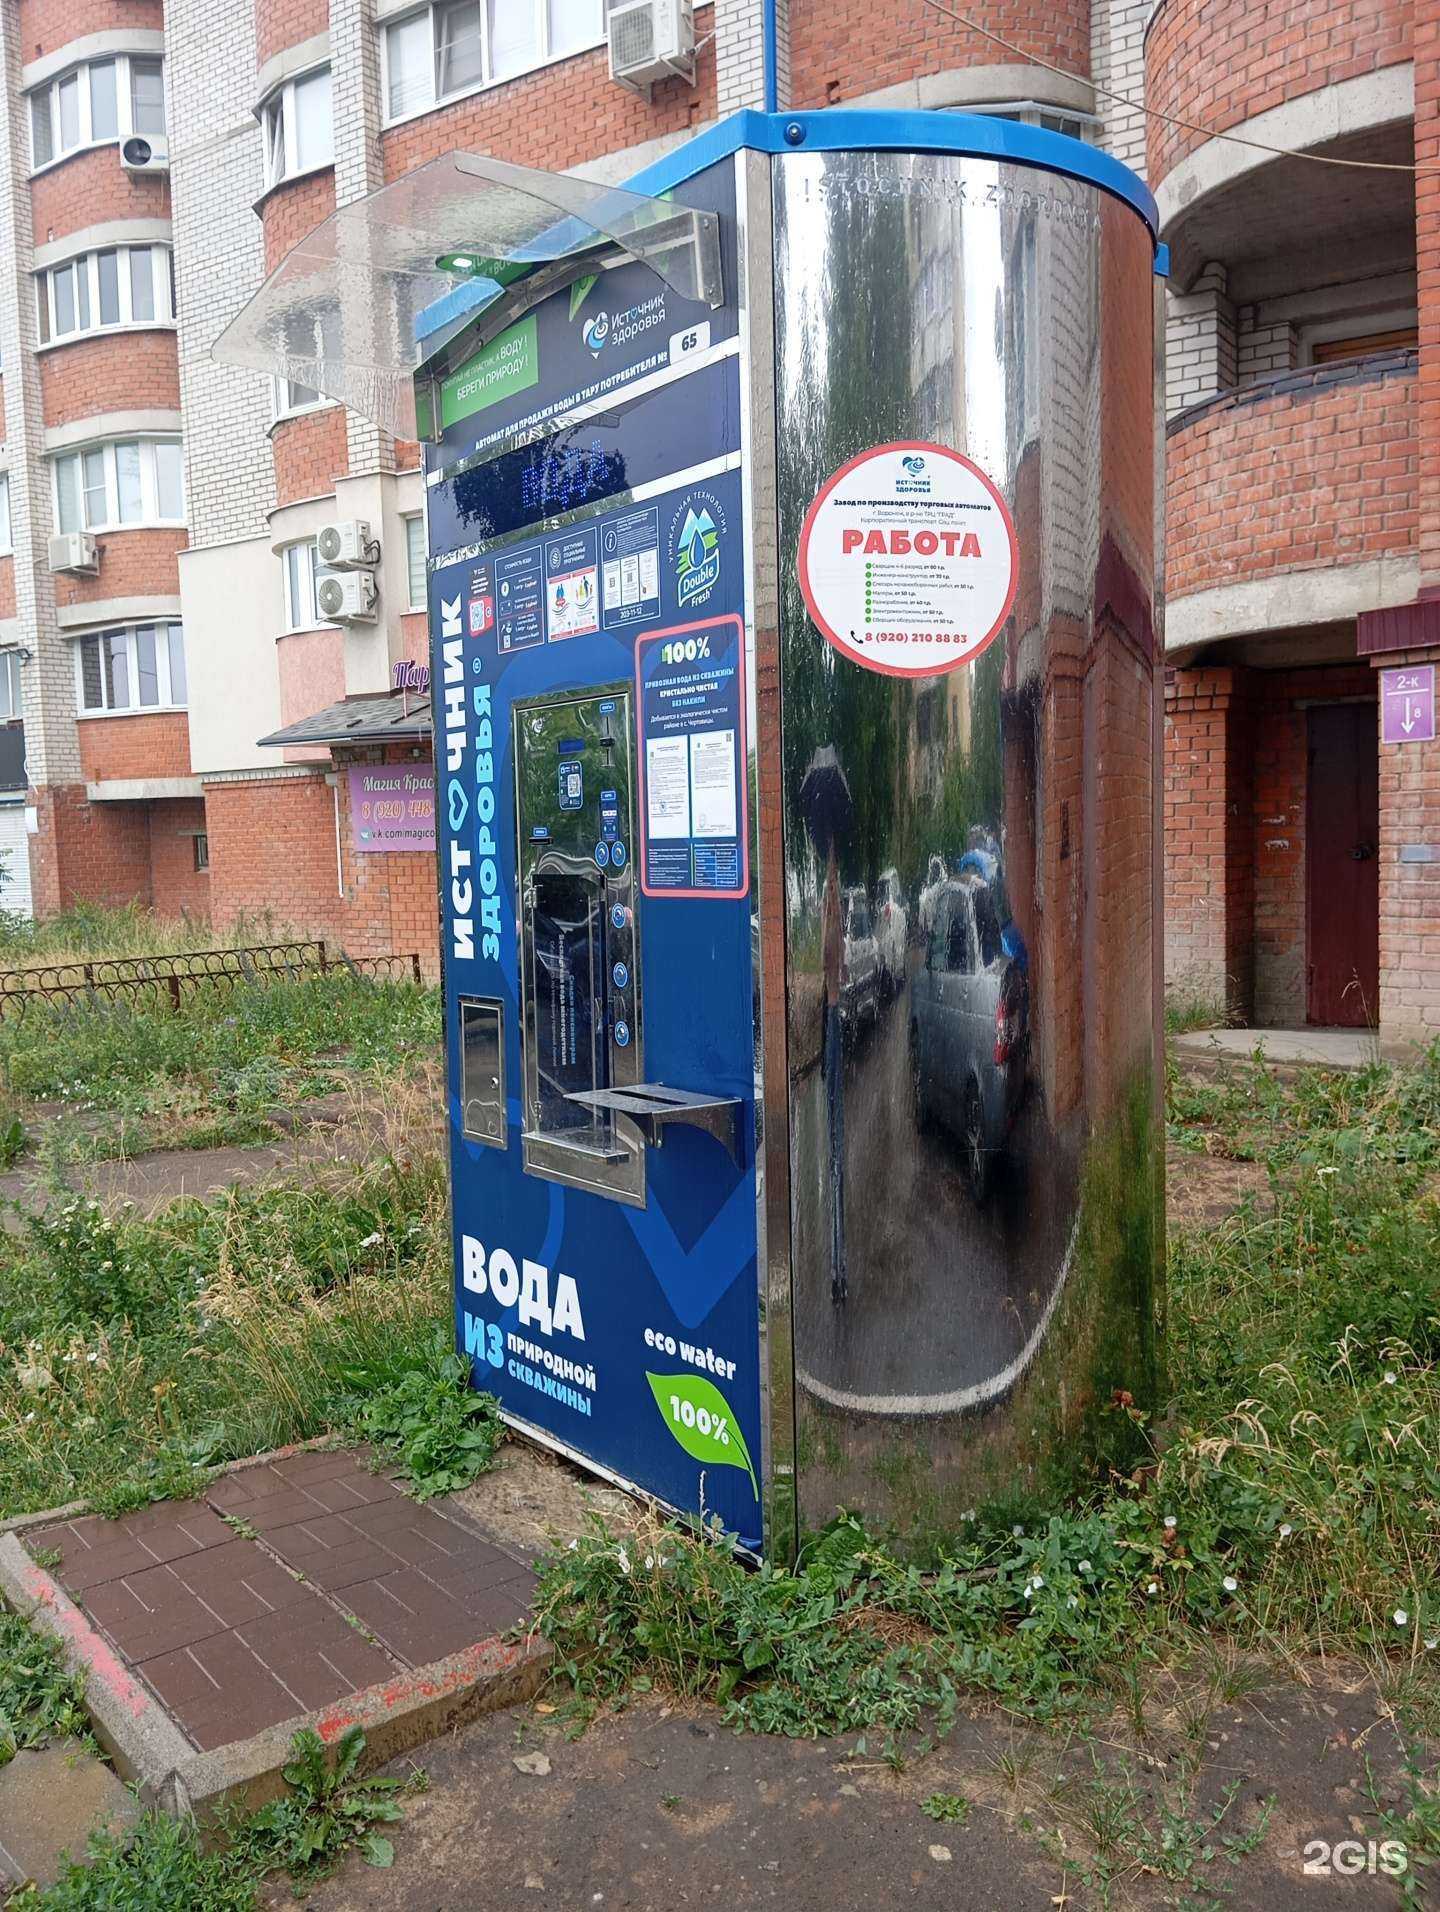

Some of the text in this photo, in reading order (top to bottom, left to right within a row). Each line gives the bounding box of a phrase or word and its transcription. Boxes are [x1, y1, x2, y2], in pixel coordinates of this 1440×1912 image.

[681, 332, 698, 351] 65
[457, 377, 485, 400] БЕРЕГИ
[475, 428, 505, 450] АВТОМАТ
[505, 422, 519, 438] ДЛЯ
[519, 407, 553, 430] ПРОДАЖИ
[554, 396, 575, 413] ВОДЫ
[581, 382, 600, 400] ТАРУ
[600, 355, 657, 391] ПОТРЕБИТЕЛЯ
[833, 499, 857, 507] Завод
[868, 500, 919, 509] производству
[920, 501, 954, 509] торговых
[955, 503, 992, 511] автоматов
[668, 495, 691, 564] УНИКАЛЬНАЯ
[693, 491, 727, 535] ТЕХНОЛОГИЯ
[842, 529, 982, 558] РАБОТА
[683, 564, 714, 593] Double
[663, 635, 710, 665] 100%
[865, 632, 967, 644] 8 (920) 210 88 83
[645, 676, 677, 689] ПРИВОЗНАЯ
[677, 675, 692, 686] ВОДА
[700, 667, 735, 680] СКВАЖИНЫ
[660, 682, 718, 698] КРИСТАЛЬНО ЧИСТАЯ
[1414, 707, 1422, 718] 8
[363, 775, 400, 792] Магия
[473, 684, 501, 963] ЗДОРОВЬЯ
[462, 1234, 585, 1342] ВОДА
[464, 1311, 596, 1391] ИЗ ПРИРОДНОЙ
[644, 1327, 736, 1381] eco water
[508, 1359, 592, 1417] СКВАЖИНЫ
[669, 1395, 730, 1446] 100%
